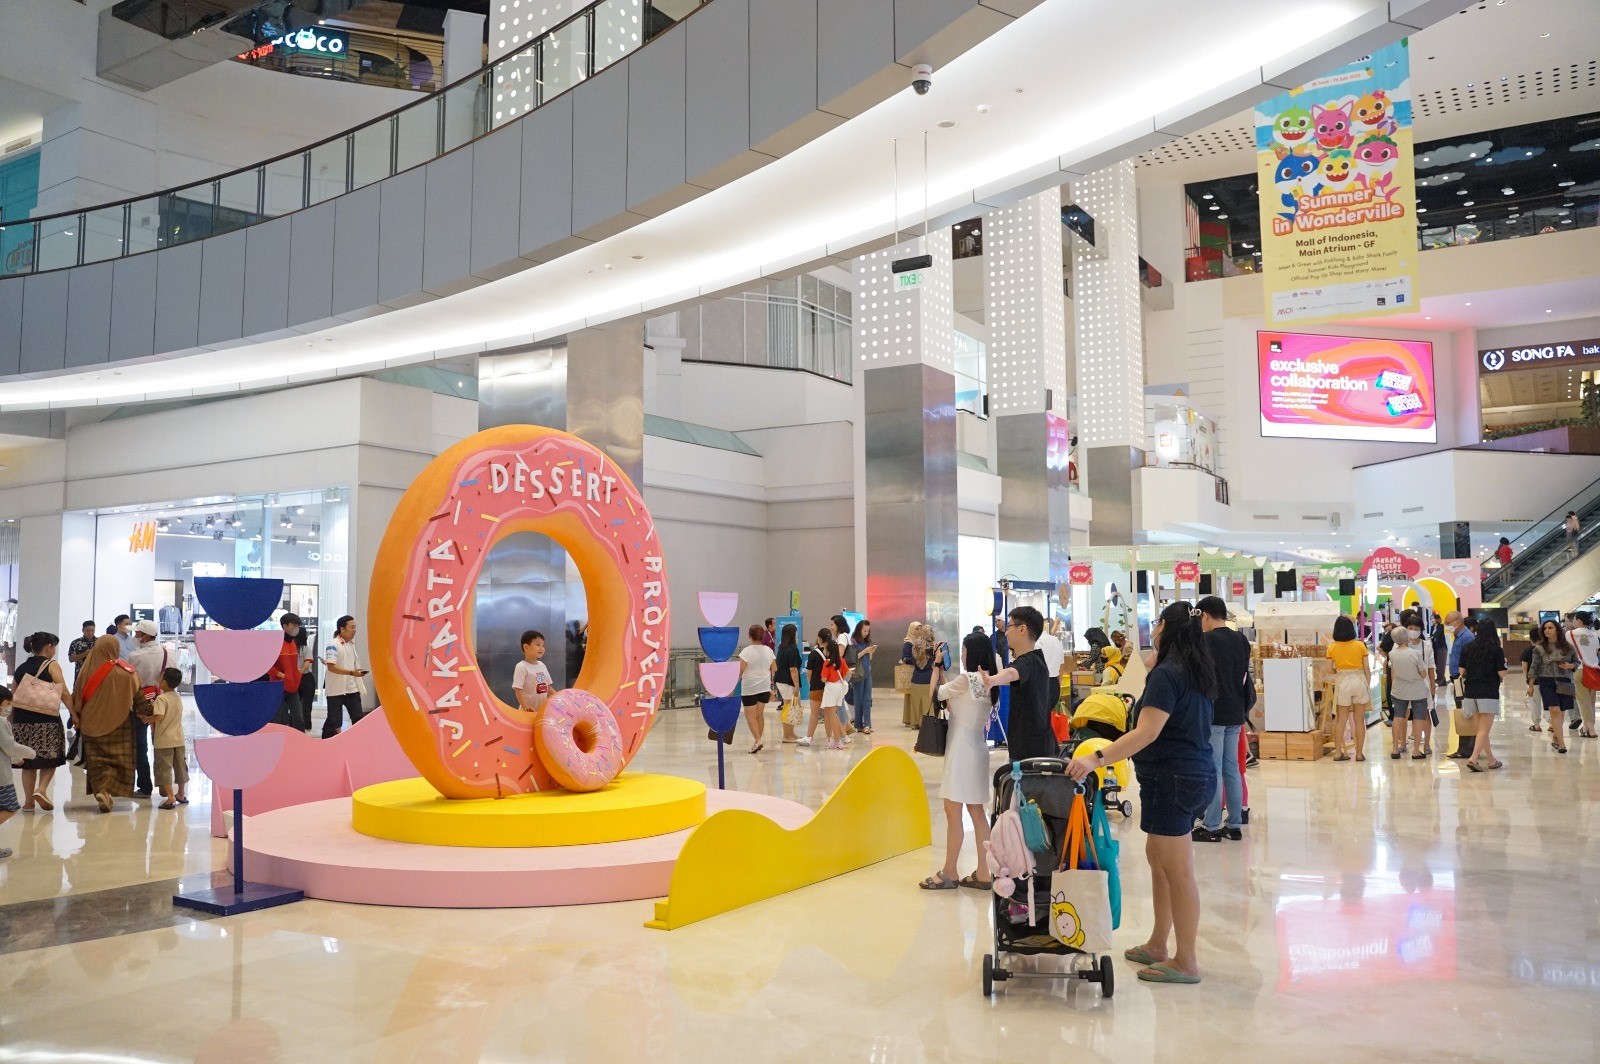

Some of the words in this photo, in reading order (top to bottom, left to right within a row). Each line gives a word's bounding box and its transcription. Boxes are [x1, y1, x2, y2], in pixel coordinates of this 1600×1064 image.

[1300, 189, 1372, 210] Summer
[1274, 219, 1290, 233] in
[1297, 202, 1401, 229] Wonderville
[1296, 238, 1315, 247] Mall
[1317, 236, 1327, 245] of
[1329, 230, 1378, 243] Indonesia,
[1299, 249, 1322, 257] Main
[1323, 244, 1356, 254] Atrium
[1364, 240, 1375, 249] GF
[1340, 260, 1369, 269] Playground
[1355, 267, 1369, 275] Many
[1511, 346, 1554, 362] SONG
[1556, 345, 1576, 358] FA
[1582, 345, 1600, 355] bak
[1270, 357, 1339, 375] exclusive
[1270, 373, 1368, 391] collaboration
[490, 462, 617, 505] DESSERT
[129, 521, 157, 553] H&M
[1372, 556, 1402, 564] JAKARTA
[427, 538, 464, 741] JAKARTA
[636, 556, 663, 715] PROJECT
